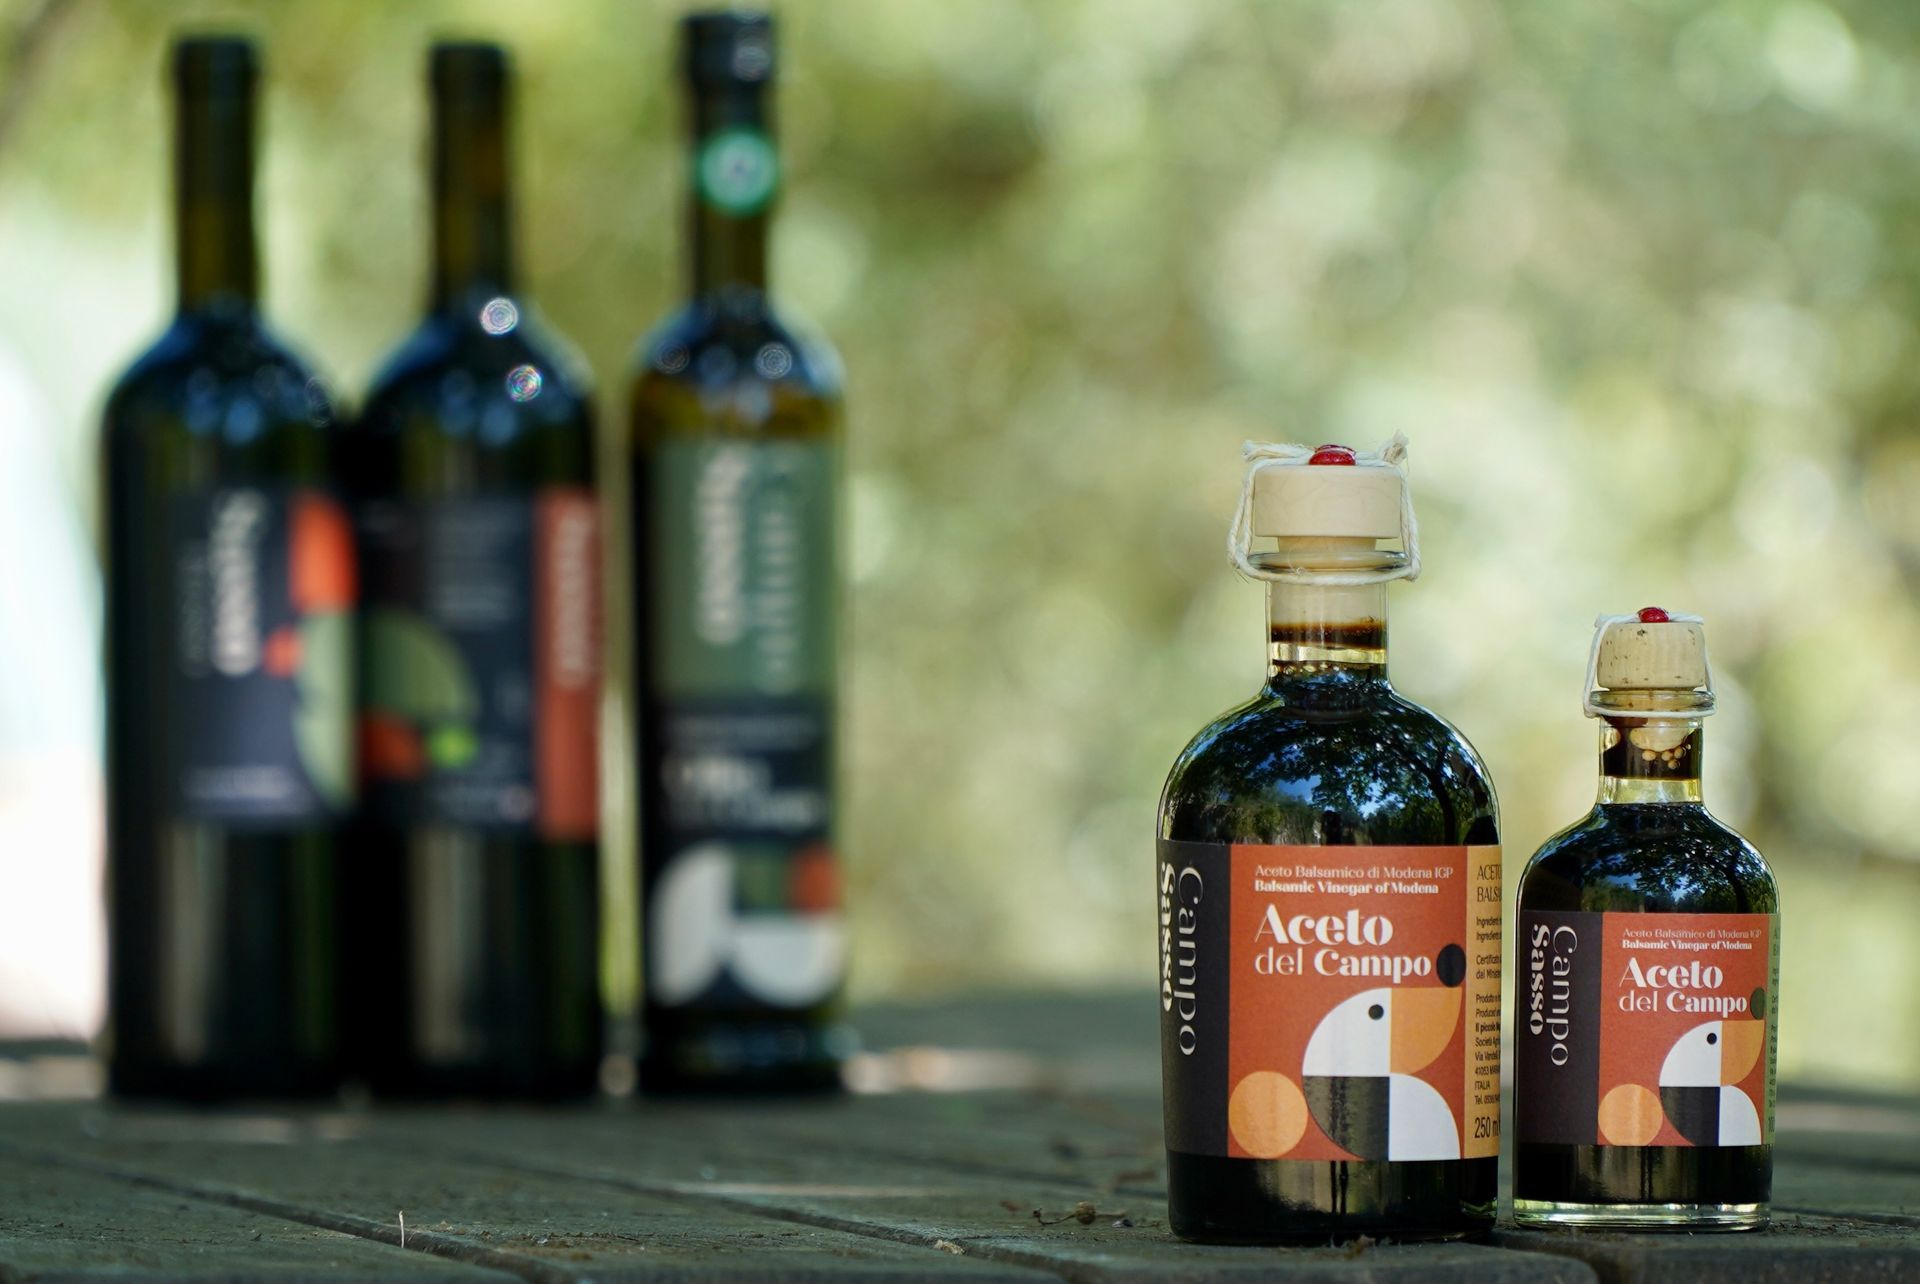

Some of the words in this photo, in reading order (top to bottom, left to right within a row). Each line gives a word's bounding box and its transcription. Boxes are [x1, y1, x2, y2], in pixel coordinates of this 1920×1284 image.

[1255, 865, 1292, 878] Aceto
[1296, 865, 1365, 879] Balsamico
[1368, 866, 1380, 879] di
[1384, 866, 1432, 879] Modena
[1434, 867, 1454, 879] IGP
[1255, 880, 1315, 893] Balsamic
[1317, 881, 1373, 896] Vinegar
[1375, 881, 1390, 894] of
[1391, 882, 1439, 894] Modena
[1160, 861, 1176, 1012] Sasso
[1255, 903, 1394, 946] Aceto
[1623, 928, 1652, 938] Aceto
[1655, 928, 1705, 939] Balsamico
[1707, 928, 1715, 939] di
[1718, 929, 1750, 939] Modena
[1174, 866, 1204, 1056] Campo
[1622, 939, 1669, 950] Balsamic
[1671, 940, 1708, 952] Vinegar
[1711, 940, 1722, 950] of
[1722, 941, 1752, 950] Modena
[1255, 946, 1303, 976] del
[1314, 948, 1432, 984] Campo
[1530, 924, 1550, 1036] Sasso
[1619, 957, 1723, 989] Aceto
[1546, 925, 1578, 1066] Campo
[1619, 989, 1658, 1012] del
[1666, 991, 1747, 1018] Campo
[1474, 1116, 1491, 1139] 250
